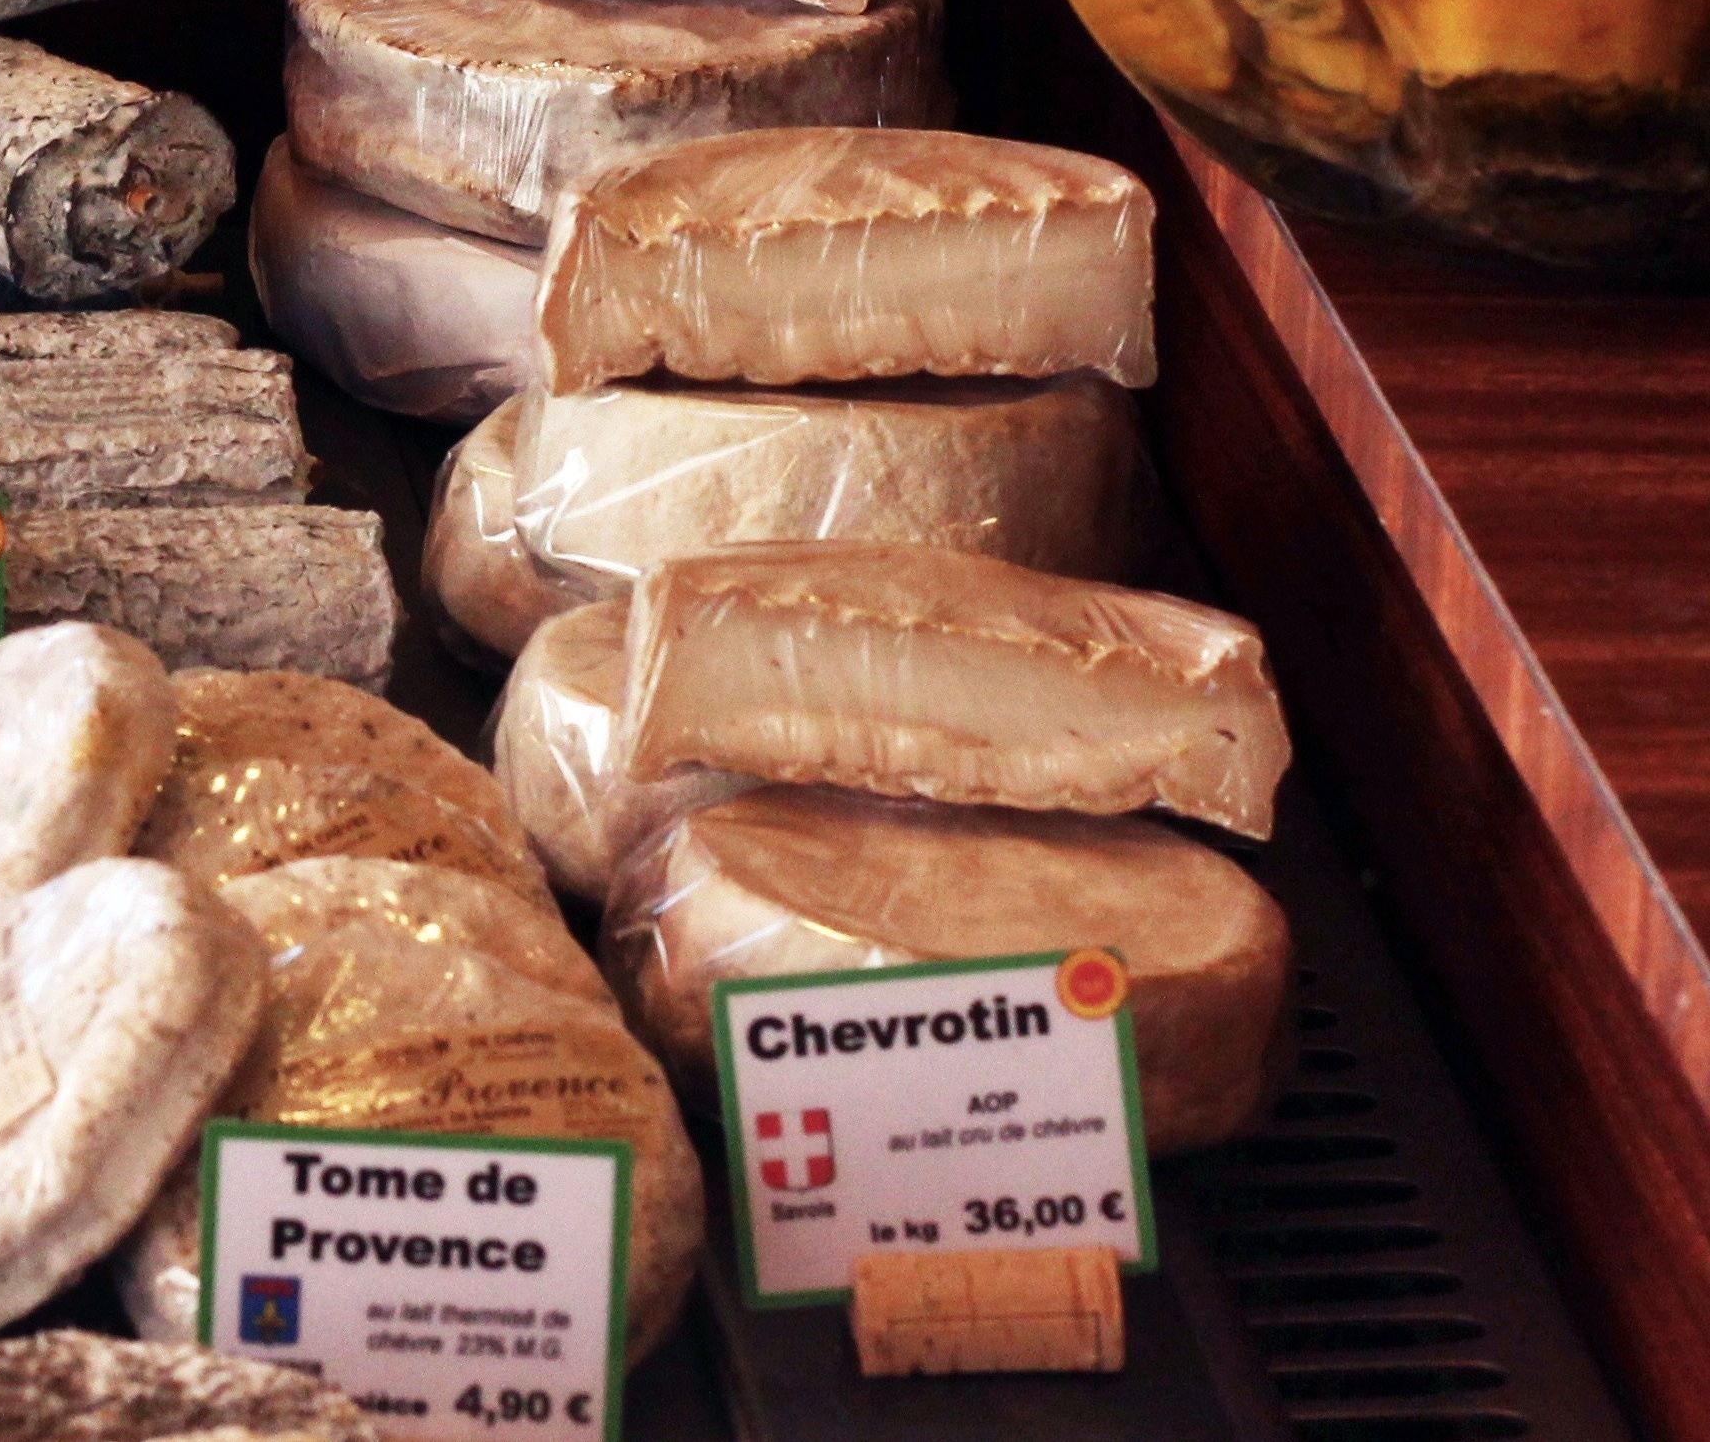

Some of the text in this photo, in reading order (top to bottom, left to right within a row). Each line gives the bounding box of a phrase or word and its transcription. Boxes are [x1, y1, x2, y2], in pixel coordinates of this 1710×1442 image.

[746, 996, 1051, 1061] Chevrotin
[967, 1090, 1019, 1115] AOP
[284, 1151, 538, 1206] Tome de
[869, 1190, 1126, 1245] le kg 36,00 €
[269, 1217, 547, 1274] Provence
[453, 1383, 552, 1427] 4,90
